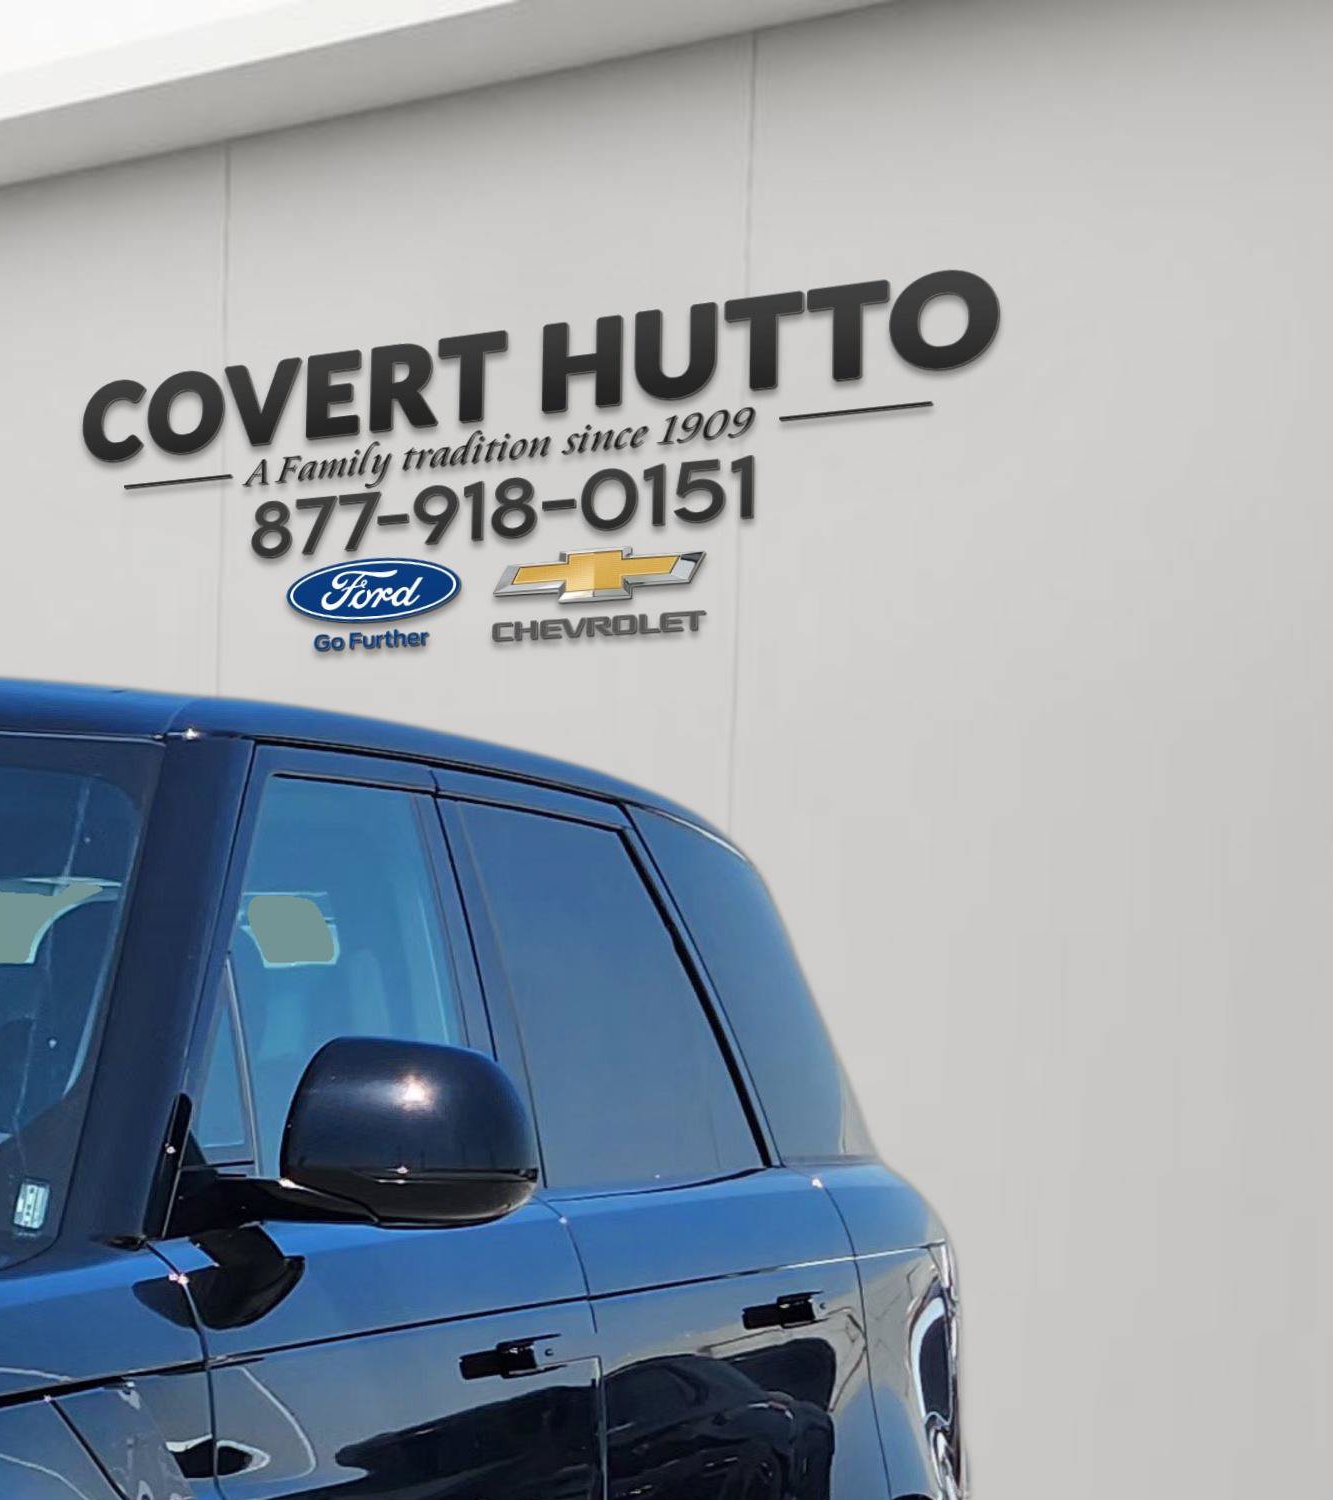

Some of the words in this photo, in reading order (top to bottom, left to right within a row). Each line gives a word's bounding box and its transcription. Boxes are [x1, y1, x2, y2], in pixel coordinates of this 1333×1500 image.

[82, 330, 509, 465] COVERT
[541, 269, 1001, 416] HUTTO
[242, 458, 270, 488] A
[274, 440, 393, 490] Family
[402, 429, 552, 472] tradition
[561, 423, 650, 457] since
[657, 406, 756, 446] 1909
[250, 454, 755, 560] 877-918-0151
[320, 569, 421, 611] Ford
[313, 634, 346, 653] Go
[348, 628, 430, 651] Further
[491, 610, 707, 643] CHEVROLET
